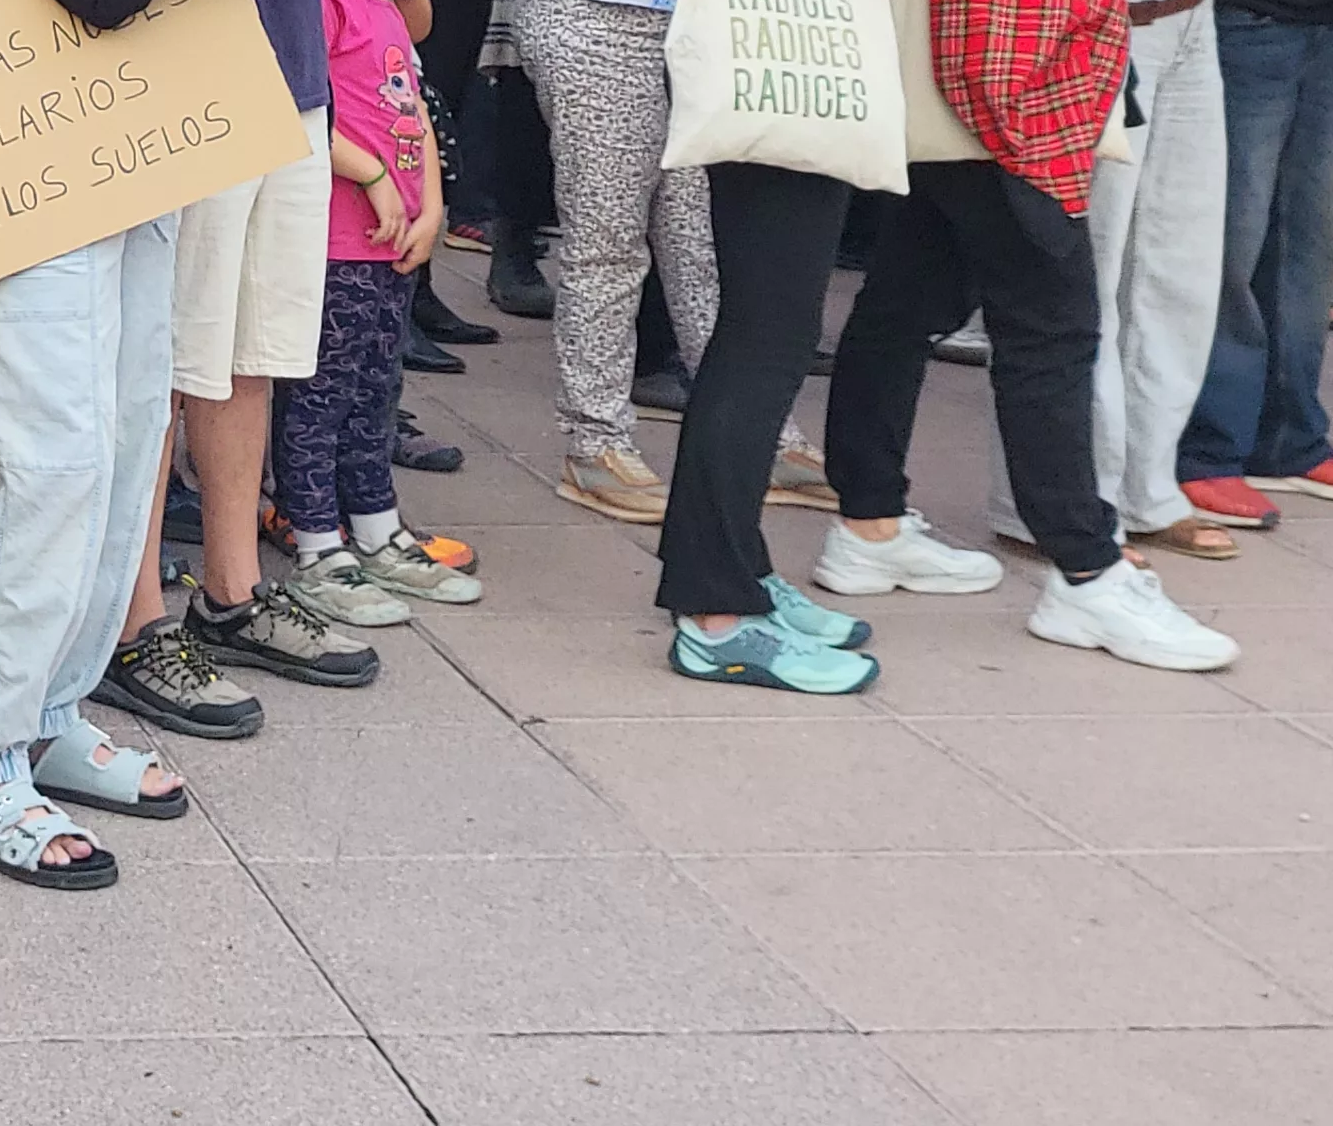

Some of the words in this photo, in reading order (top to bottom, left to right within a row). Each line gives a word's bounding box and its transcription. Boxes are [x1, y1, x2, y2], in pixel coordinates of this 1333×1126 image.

[729, 16, 863, 71] RADICES
[732, 67, 869, 122] RADICES
[0, 162, 69, 218] LOS
[88, 98, 233, 188] SUELOS
